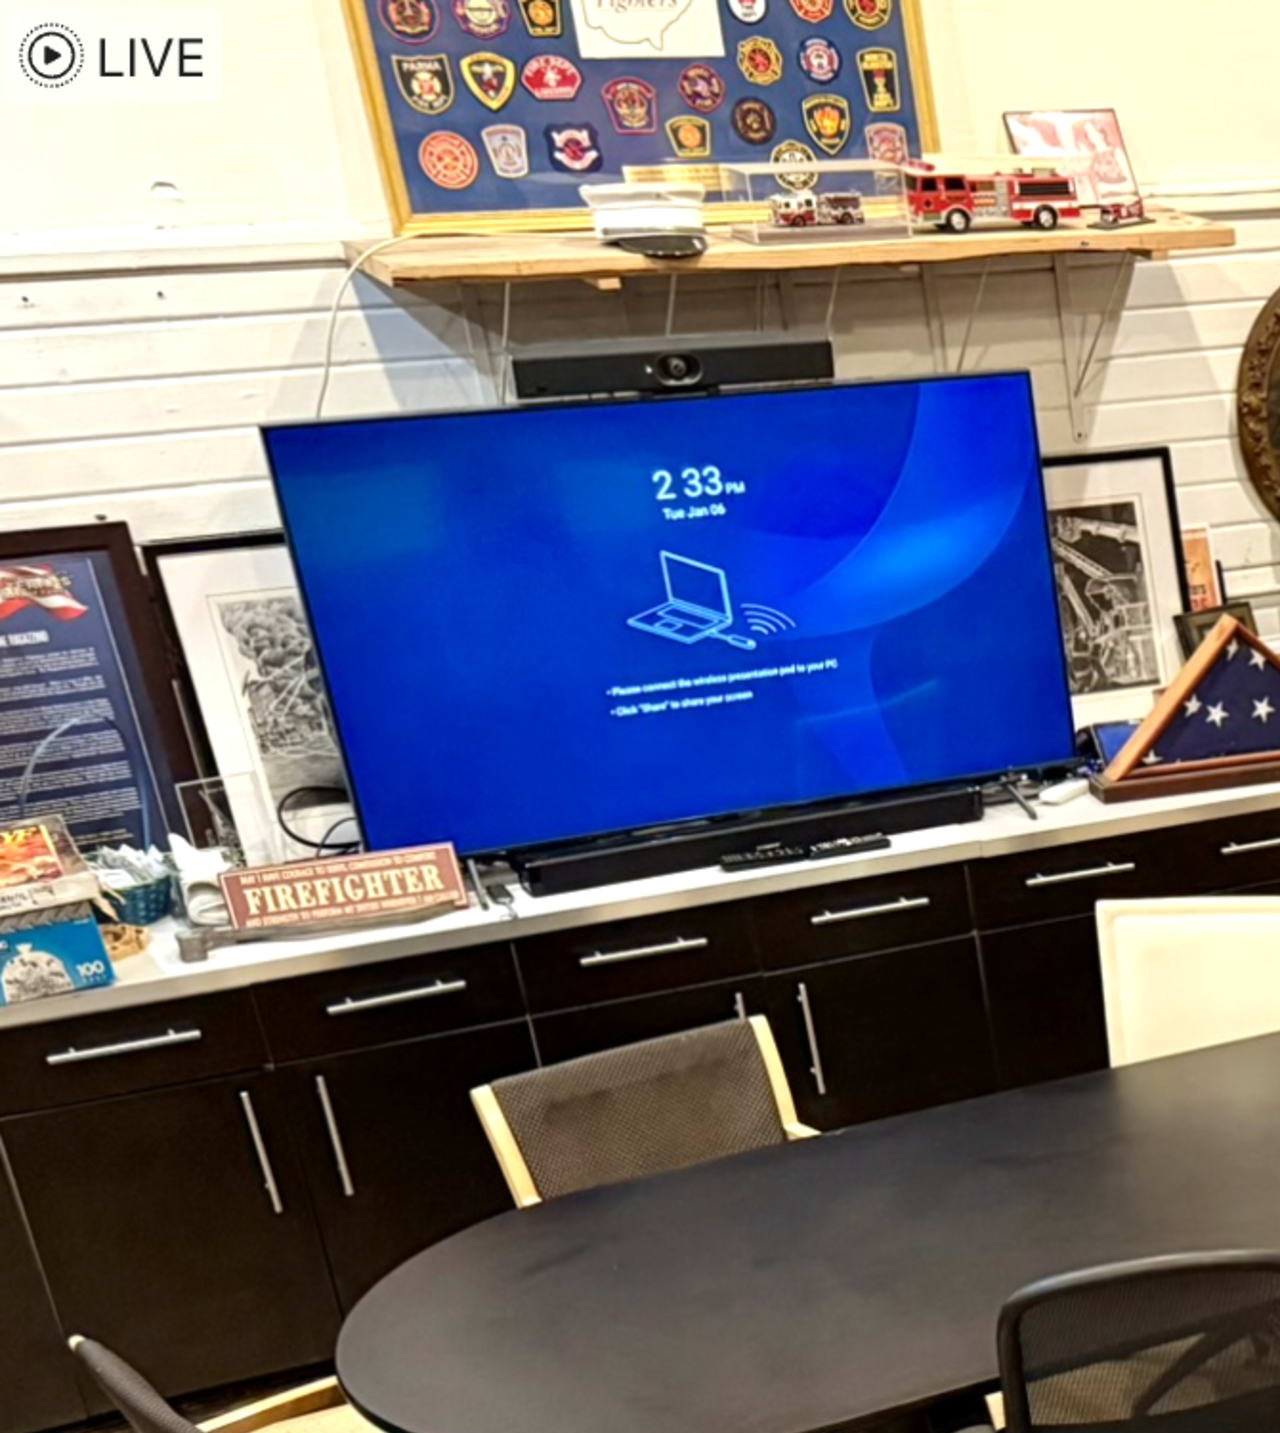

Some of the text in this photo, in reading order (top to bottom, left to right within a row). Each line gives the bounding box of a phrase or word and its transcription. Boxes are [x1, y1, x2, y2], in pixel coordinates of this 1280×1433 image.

[725, 481, 745, 495] PM
[662, 507, 685, 520] Tue
[687, 505, 709, 519] Jan
[612, 686, 641, 697] Please
[642, 681, 677, 692] connect
[678, 678, 692, 688] the
[825, 658, 839, 669] PC
[616, 705, 638, 716] Click
[681, 697, 704, 708] share
[705, 695, 724, 707] your
[725, 691, 753, 702] screen
[243, 866, 444, 915] FIREFIGHTER
[76, 961, 105, 978] 100
